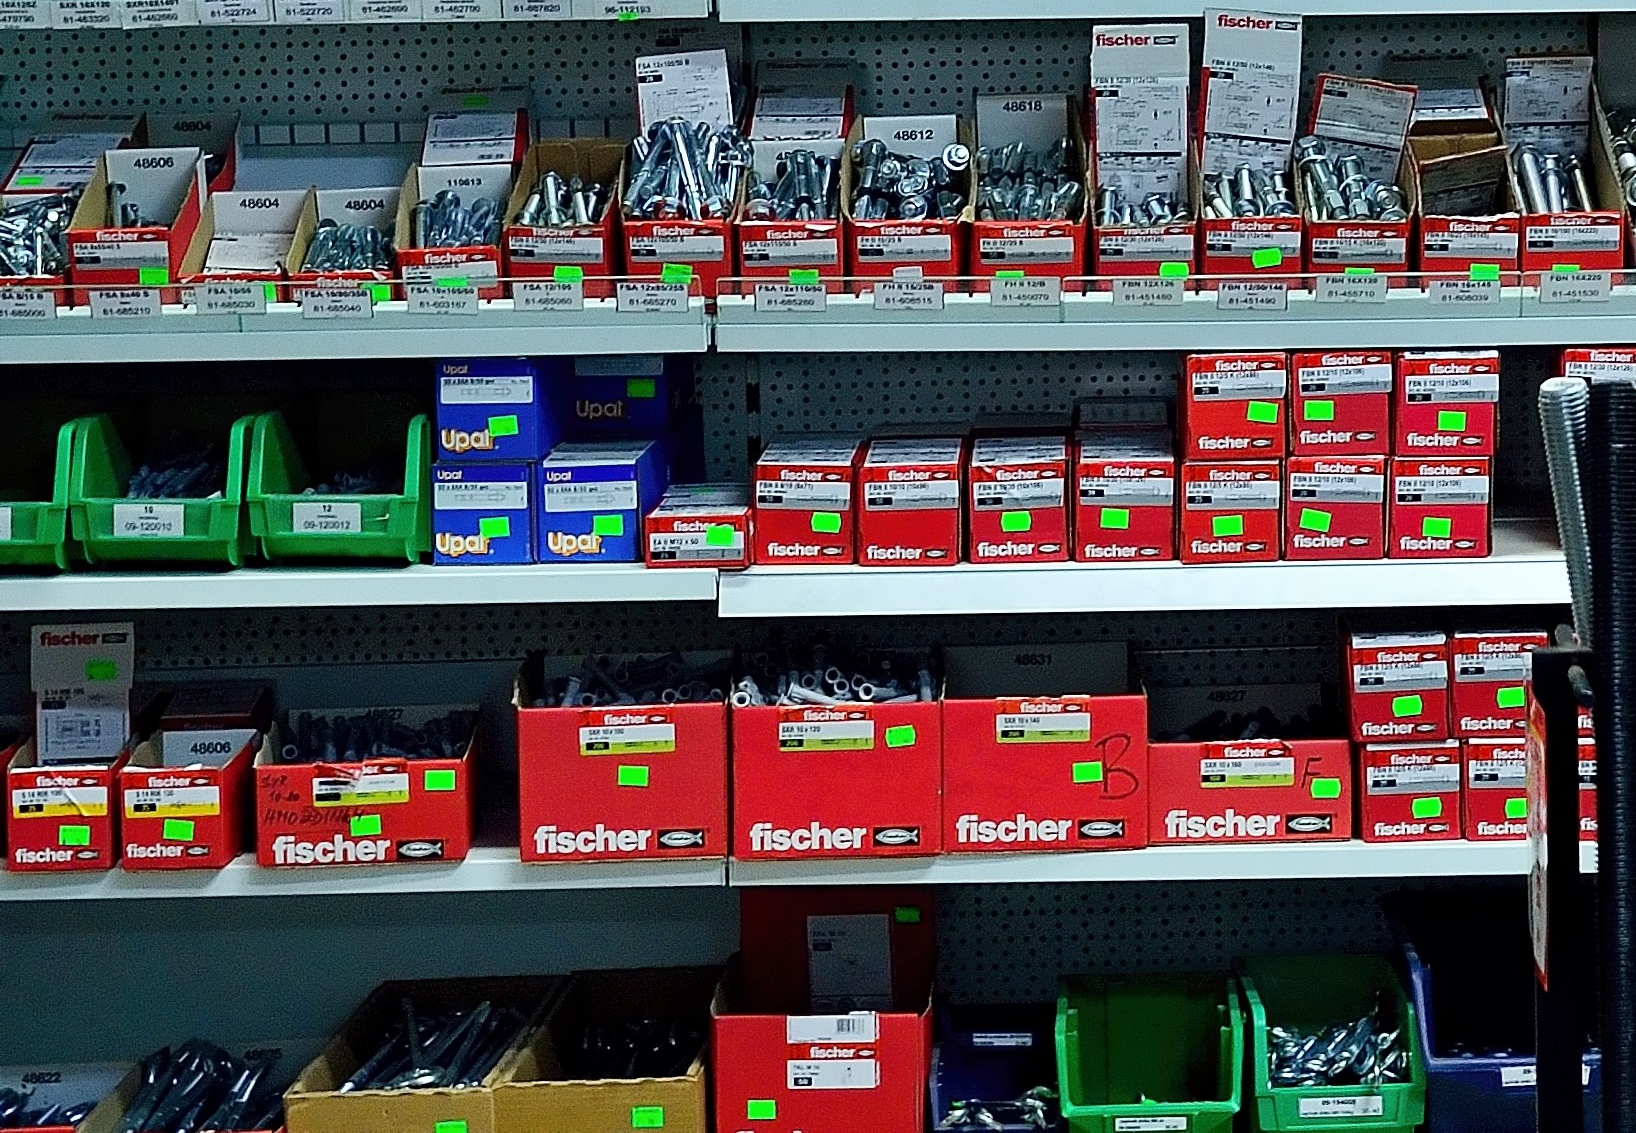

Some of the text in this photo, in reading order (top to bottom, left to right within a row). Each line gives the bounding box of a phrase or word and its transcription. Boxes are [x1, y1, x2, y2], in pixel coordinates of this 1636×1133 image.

[1218, 15, 1275, 29] fischer
[1096, 33, 1150, 47] fischer
[1002, 100, 1042, 113] 48618
[894, 129, 934, 143] 48612
[134, 155, 174, 169] 48606
[240, 197, 279, 211] 48604
[345, 197, 384, 212] 48604
[880, 225, 923, 237] fischer
[424, 253, 466, 264] fischer
[1198, 435, 1250, 451] fischer
[1300, 429, 1353, 445] fischer
[1407, 433, 1460, 448] fischer
[546, 469, 573, 482] Upat
[1104, 465, 1148, 477] fischer
[548, 531, 602, 556] Upat
[1192, 539, 1244, 554] fischer
[1294, 534, 1346, 549] fischer
[1400, 536, 1453, 551] fischer
[768, 542, 820, 558] fischer
[867, 545, 922, 561] fischer
[977, 541, 1035, 558] fischer
[1084, 543, 1138, 559] fischer
[604, 713, 648, 725] fischer
[1461, 717, 1514, 733] fischer
[1362, 721, 1414, 737] fischer
[190, 741, 231, 755] 48606
[956, 813, 1072, 843] fischer
[1165, 809, 1280, 839] fischer
[1374, 821, 1426, 837] fischer
[534, 824, 652, 854] fischer
[750, 822, 867, 851] fischer
[16, 847, 74, 865] fischer
[126, 843, 183, 859] fischer
[273, 834, 391, 865] fischer
